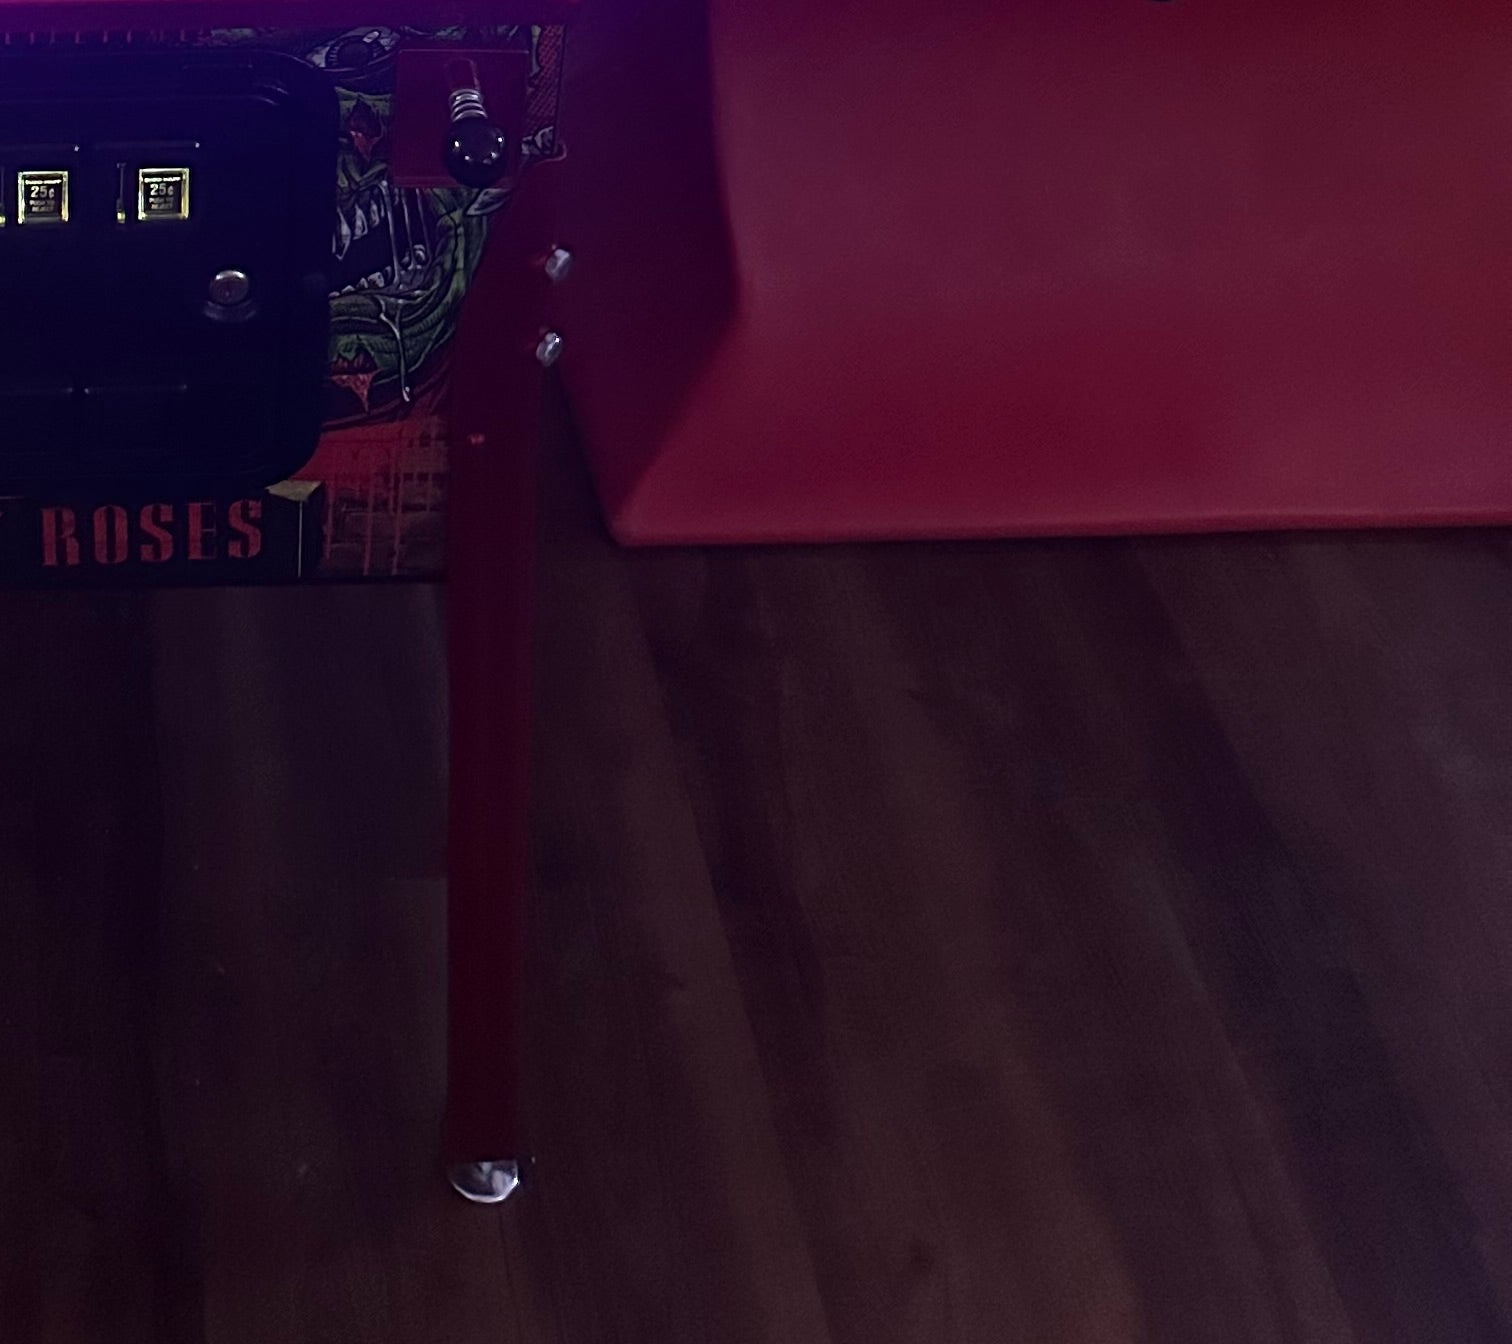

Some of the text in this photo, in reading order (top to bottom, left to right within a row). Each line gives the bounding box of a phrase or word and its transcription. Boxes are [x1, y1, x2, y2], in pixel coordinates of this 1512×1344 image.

[30, 185, 55, 198] 25¢
[149, 183, 174, 196] 25¢
[41, 499, 264, 567] ROSES
